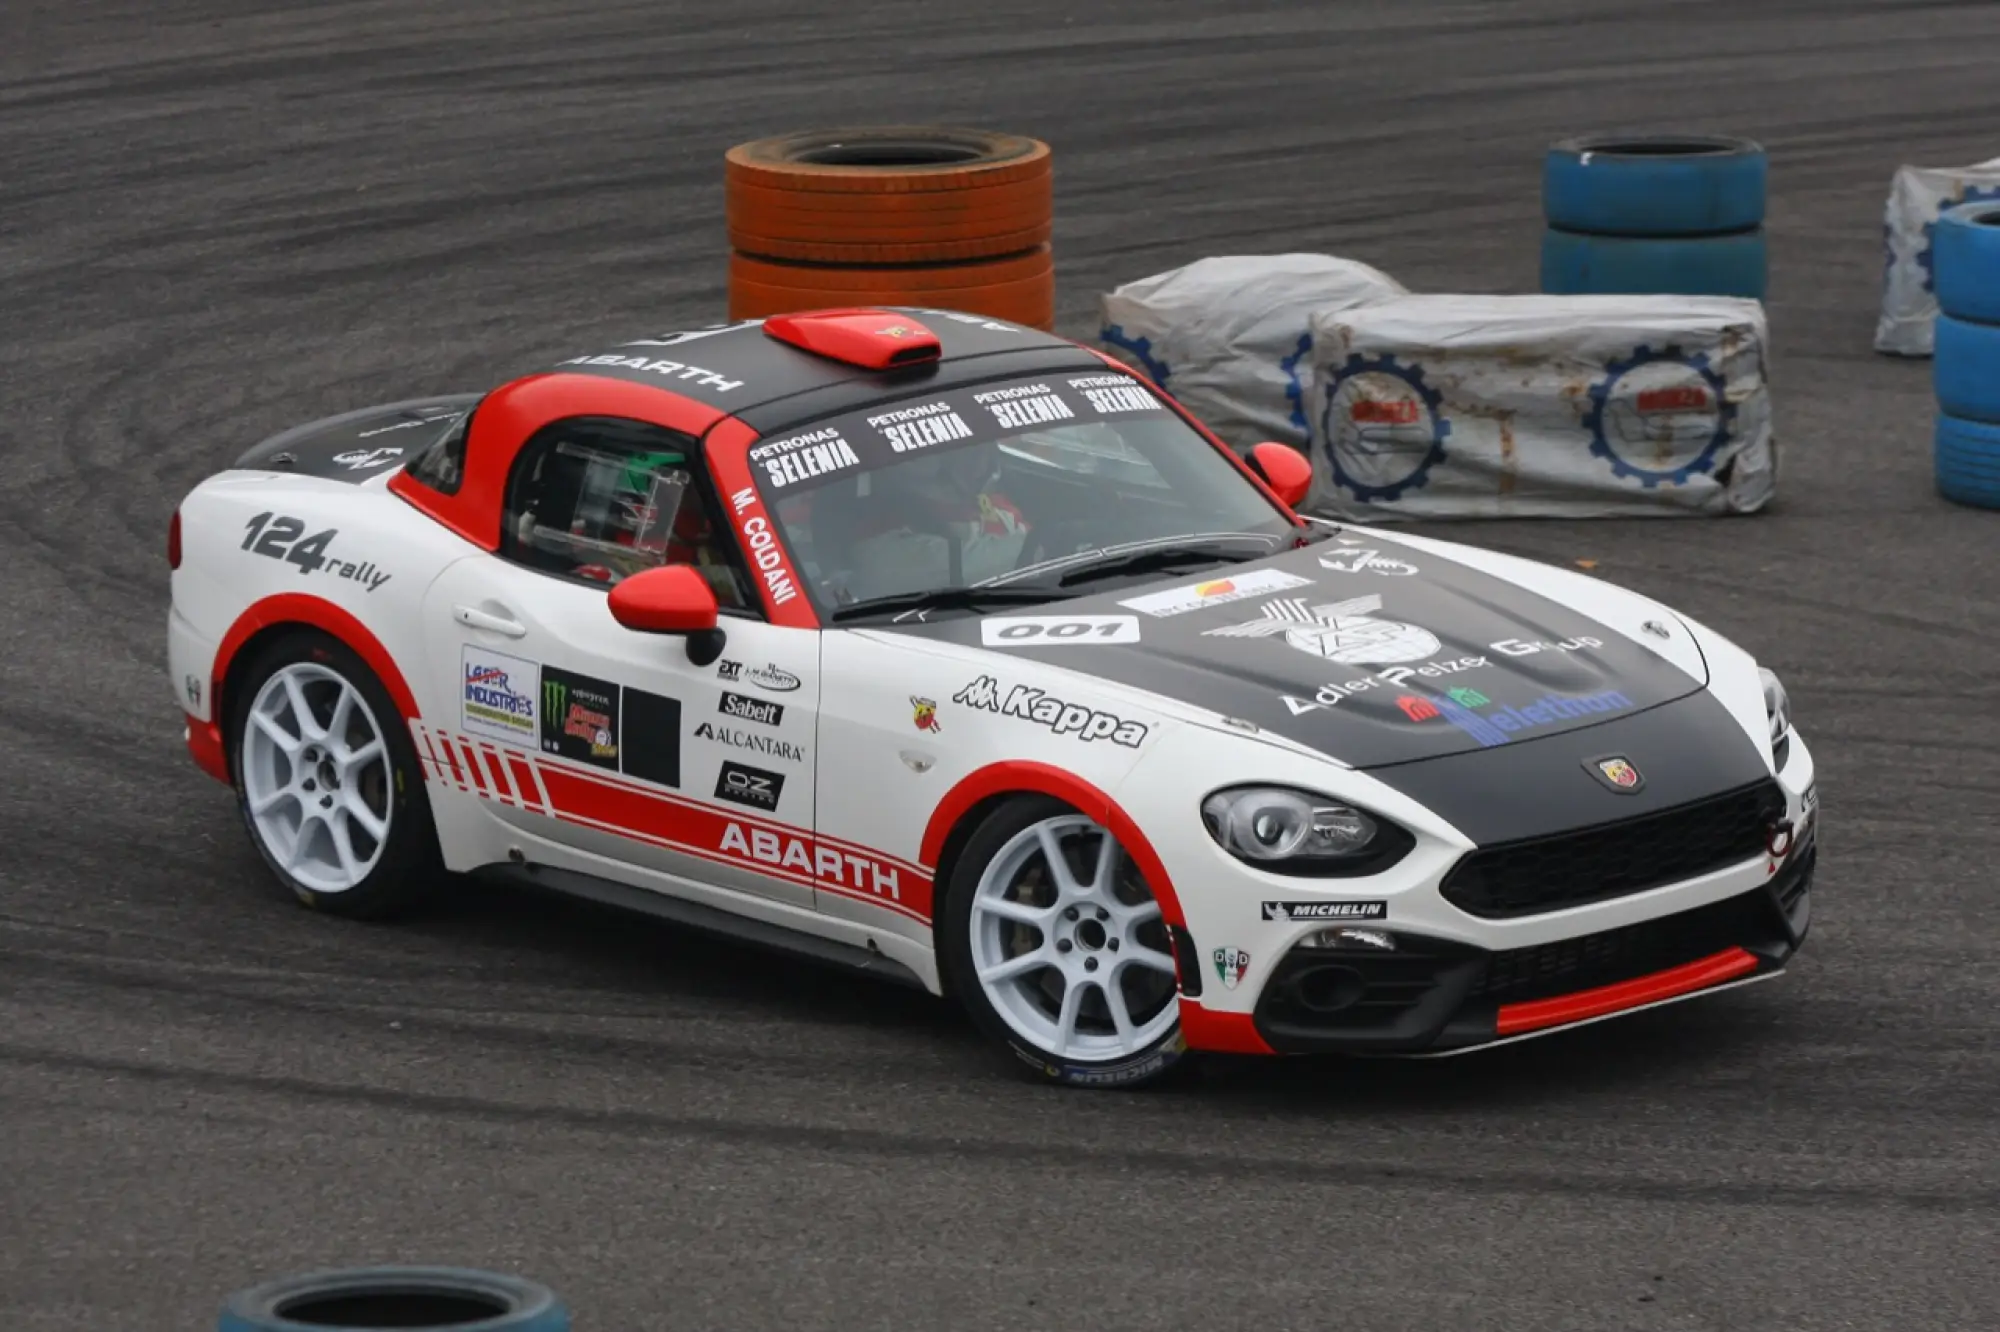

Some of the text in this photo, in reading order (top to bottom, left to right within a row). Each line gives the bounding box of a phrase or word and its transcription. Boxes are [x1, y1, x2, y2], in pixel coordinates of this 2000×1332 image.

[555, 354, 744, 392] ABARTH
[1067, 375, 1137, 389] PETRONAS
[973, 383, 1052, 404] PETRONAS
[1085, 386, 1162, 413] SELENIA
[867, 401, 951, 428] PETRONAS
[990, 394, 1075, 429] SELENIA
[750, 427, 840, 462] PETRONAS
[884, 411, 974, 453] SELENIA
[765, 438, 860, 488] SELENIA
[241, 511, 392, 593] 124 rally
[731, 487, 797, 606] M. COLDANI
[997, 622, 1124, 639] 001
[1279, 676, 1381, 716] Adler
[1378, 653, 1487, 688] Pelzer
[725, 694, 777, 725] Sabelt
[1001, 684, 1149, 749] Kappa
[719, 822, 900, 900] ABARTH
[1293, 903, 1382, 917] MICHELIN
